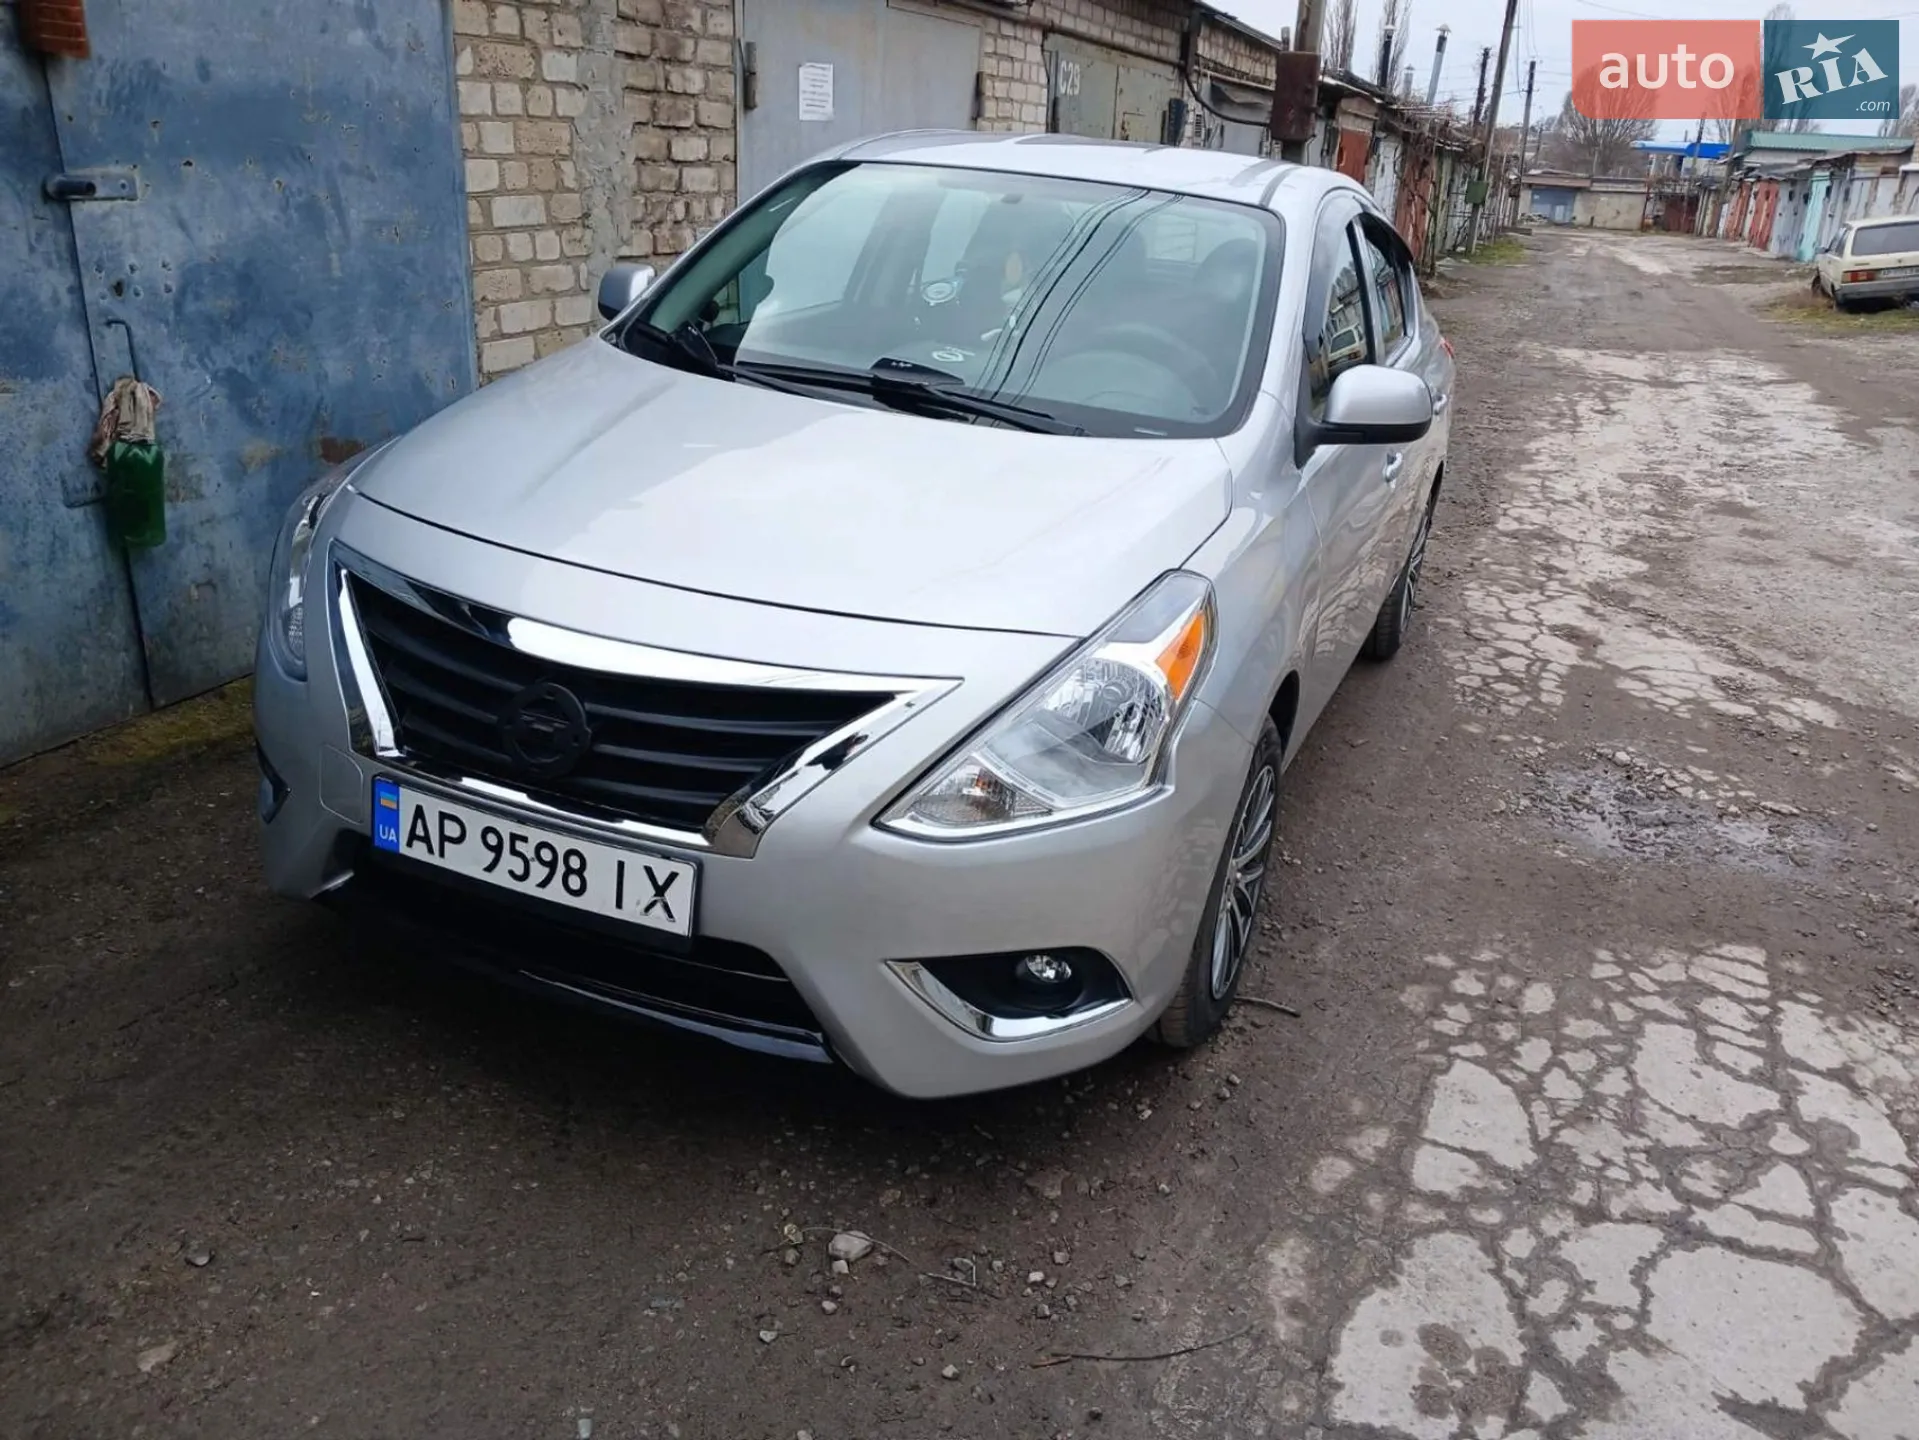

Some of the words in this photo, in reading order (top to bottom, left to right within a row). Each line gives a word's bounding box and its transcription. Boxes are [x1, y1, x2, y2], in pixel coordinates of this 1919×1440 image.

[379, 825, 397, 842] UA
[406, 804, 467, 858] AP
[480, 826, 587, 897] 9598
[615, 860, 679, 922] IX
